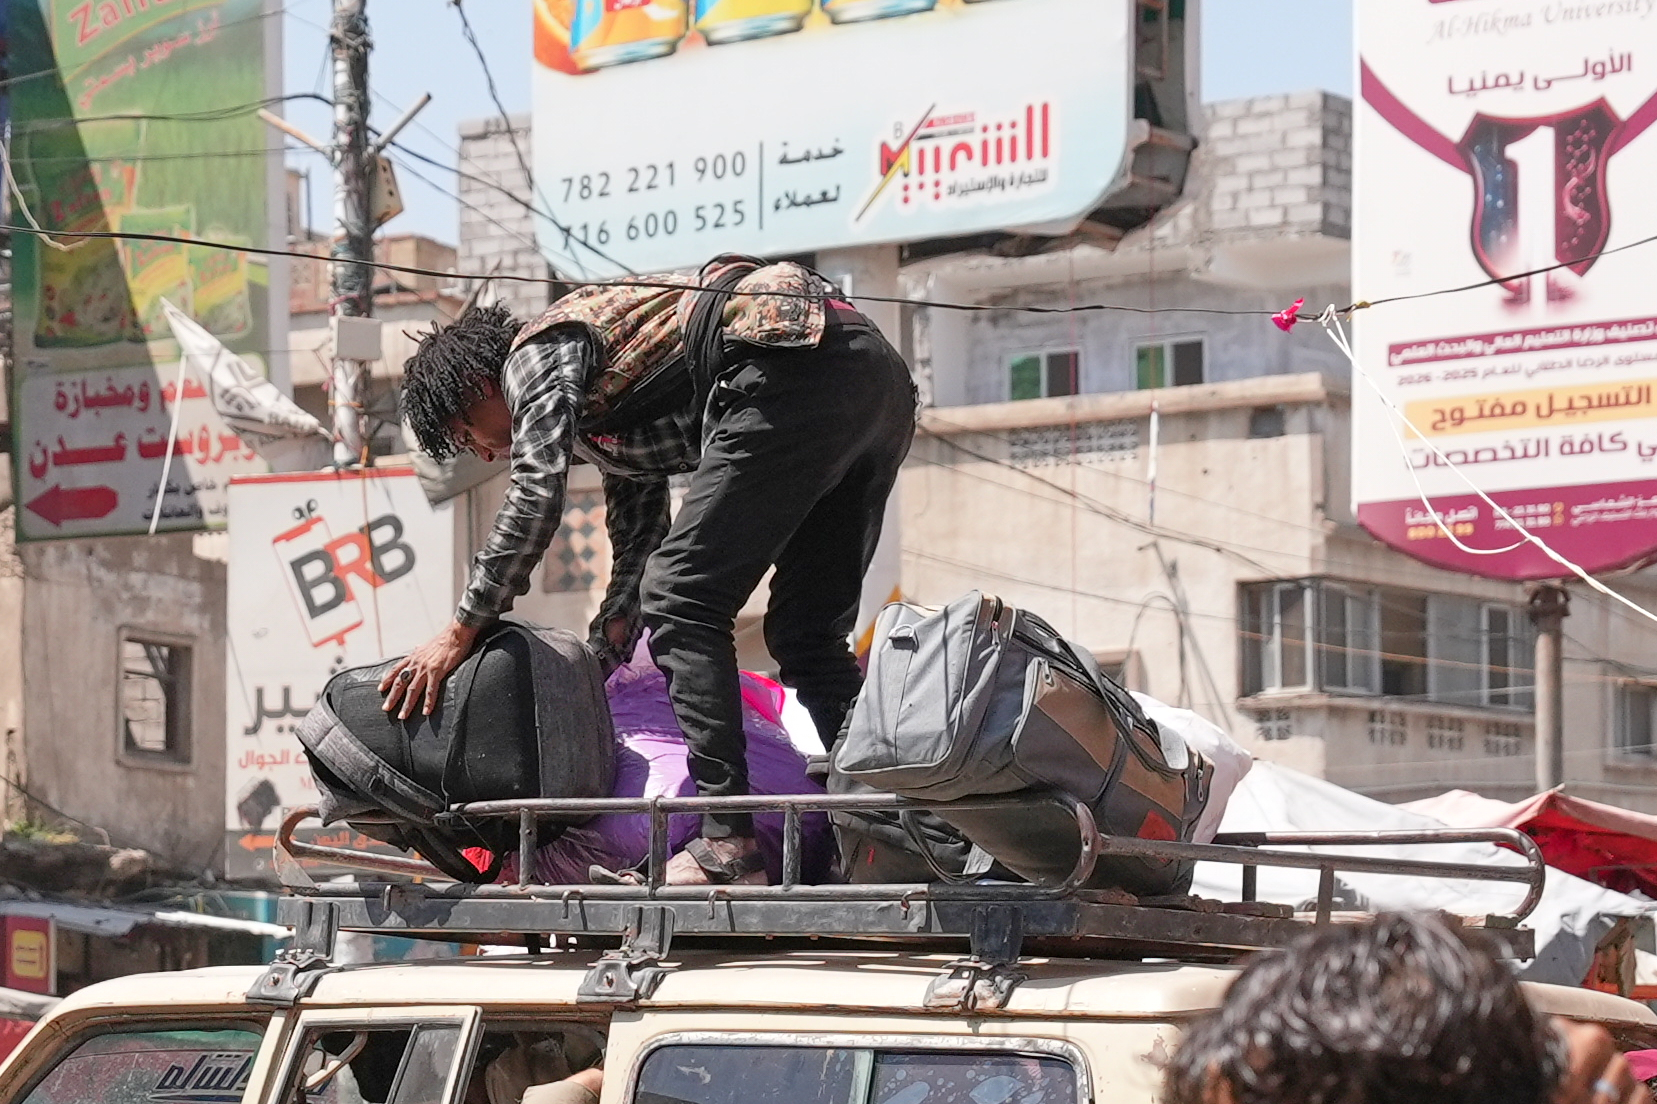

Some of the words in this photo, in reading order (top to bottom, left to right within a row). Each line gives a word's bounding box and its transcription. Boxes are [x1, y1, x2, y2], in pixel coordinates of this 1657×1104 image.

[561, 171, 611, 203] 782
[627, 160, 675, 193] 221
[694, 151, 745, 182] 900
[626, 209, 677, 241] 600
[694, 200, 745, 232] 525
[1430, 398, 1528, 432] مفتوح
[1535, 384, 1653, 419] التسجيل
[29, 430, 128, 480] عدن
[1406, 436, 1551, 471] التخصصات
[1559, 431, 1629, 457] كافة
[289, 512, 418, 620] BRB
